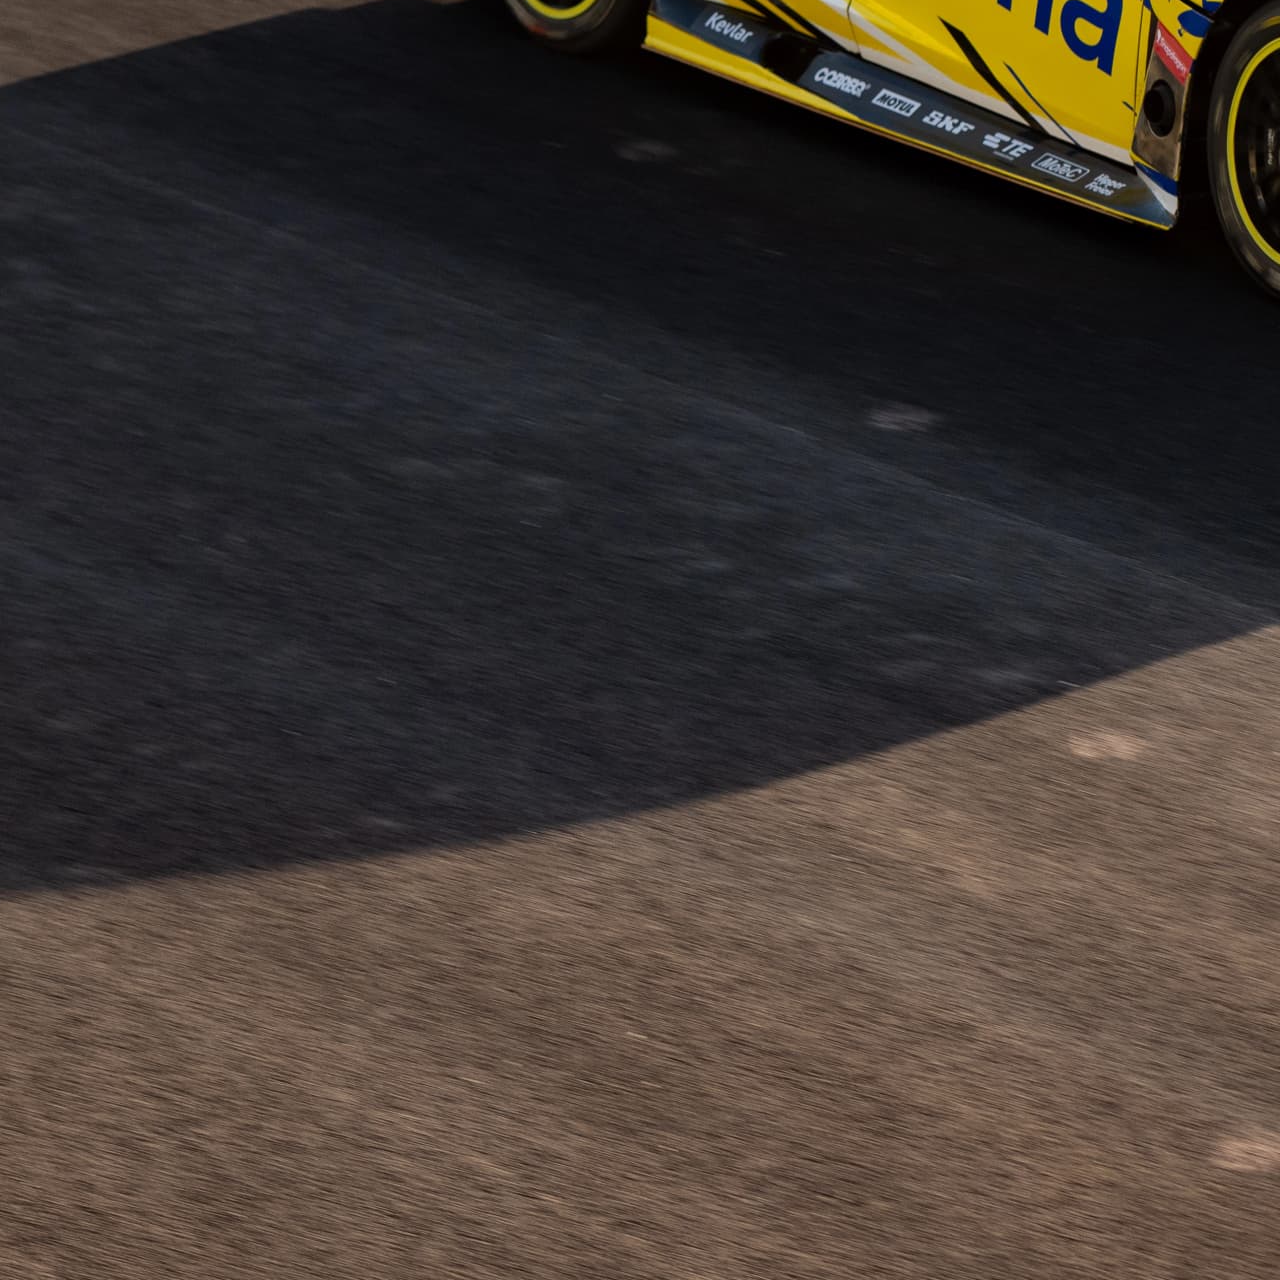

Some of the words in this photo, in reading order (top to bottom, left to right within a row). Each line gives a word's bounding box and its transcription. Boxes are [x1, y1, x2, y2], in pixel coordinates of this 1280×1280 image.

[705, 11, 754, 44] Kevlar
[876, 92, 916, 114] MOTUL
[922, 110, 975, 135] SKF
